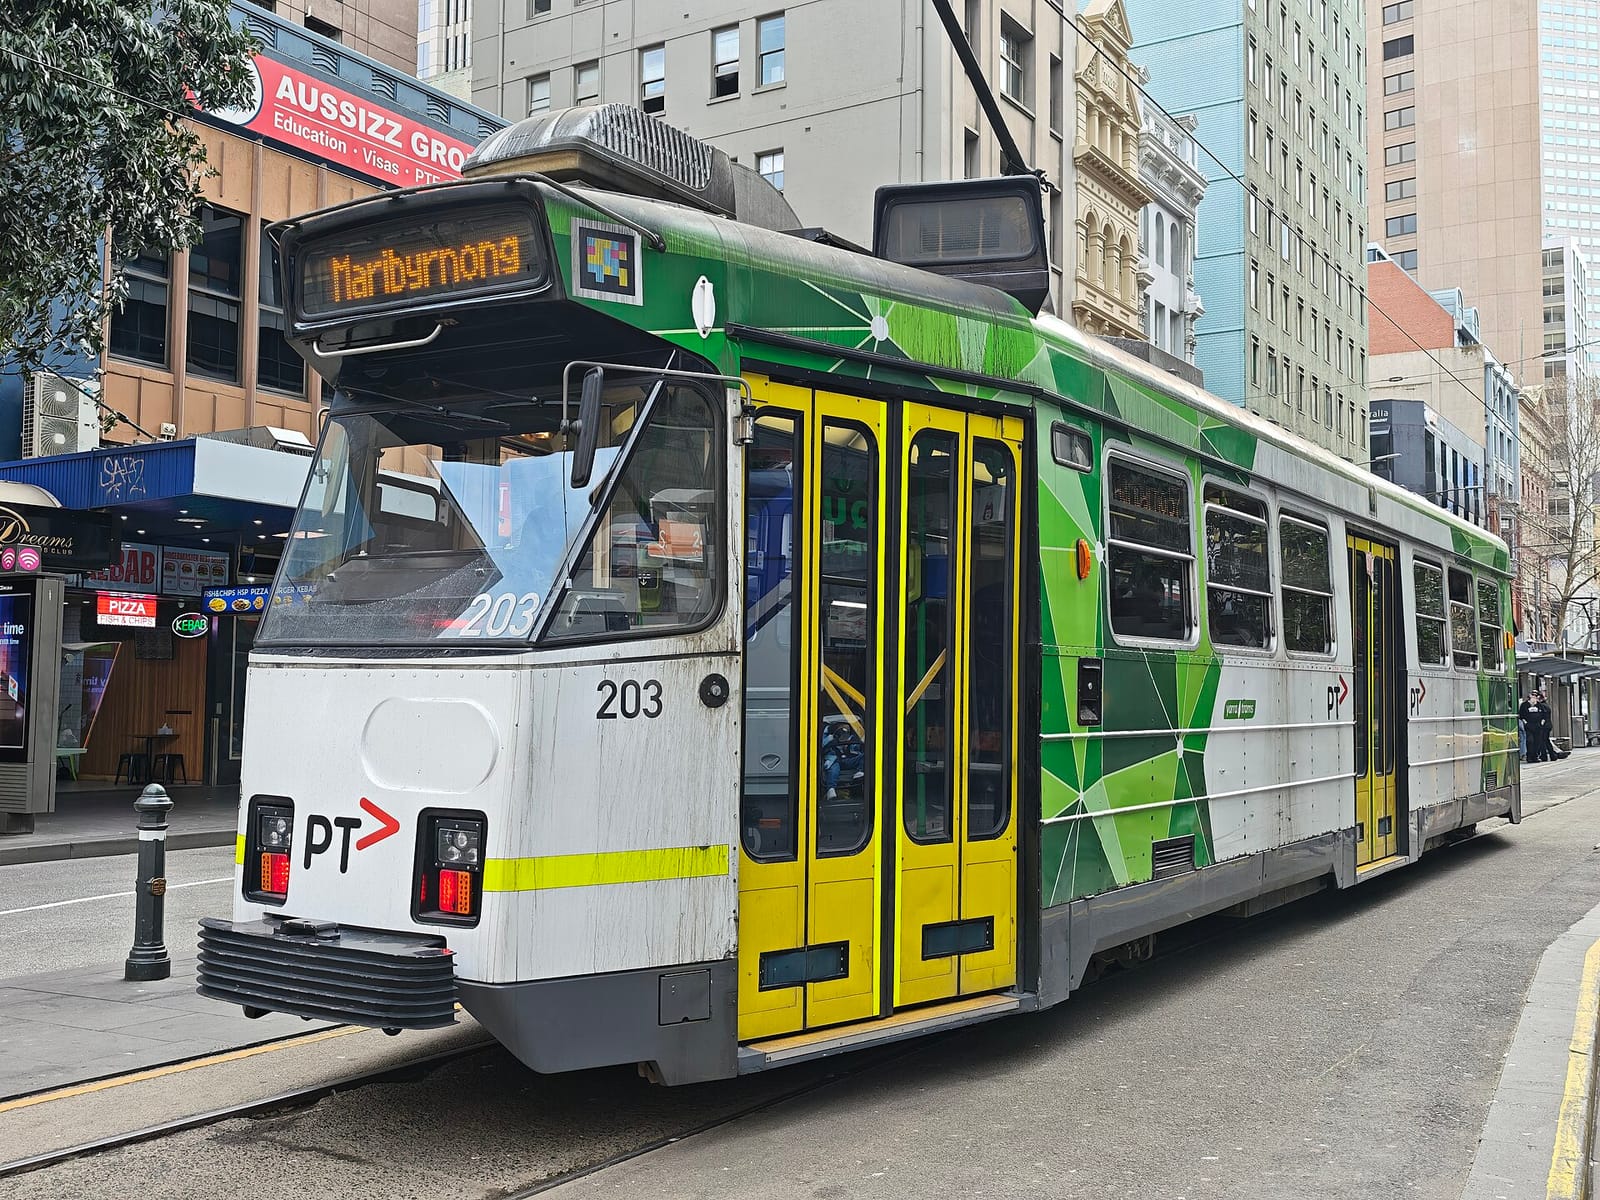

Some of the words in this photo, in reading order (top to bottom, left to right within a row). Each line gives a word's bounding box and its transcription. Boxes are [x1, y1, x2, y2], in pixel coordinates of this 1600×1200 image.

[275, 74, 403, 149] AUSSIZZ
[411, 131, 472, 173] GRO
[274, 111, 347, 154] Education
[362, 147, 400, 175] Visas
[331, 236, 521, 302] Maribyrnong
[0, 514, 73, 549] Dreams
[109, 600, 146, 615] PIZZA
[250, 587, 269, 595] PIZZA
[4, 621, 24, 635] time
[100, 615, 119, 624] FISH
[121, 616, 127, 624] &
[128, 616, 154, 626] CHIPS
[175, 618, 207, 631] KEBAB
[459, 592, 540, 637] 203
[596, 679, 663, 719] 203
[303, 814, 362, 874] PT
